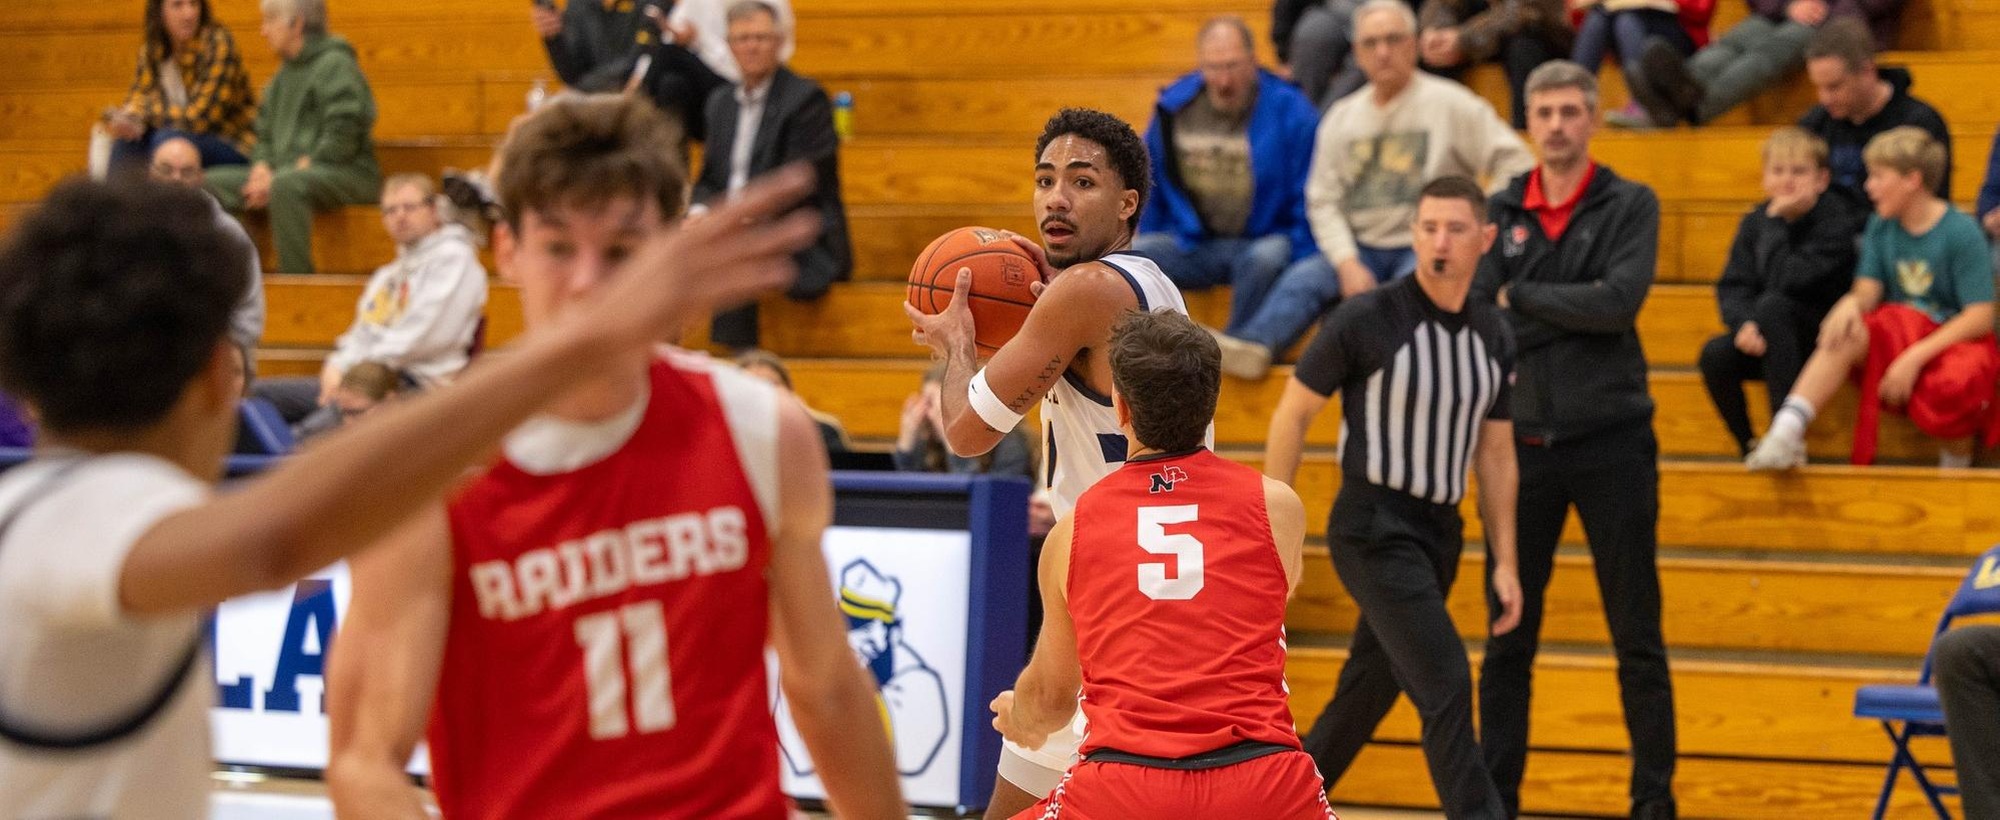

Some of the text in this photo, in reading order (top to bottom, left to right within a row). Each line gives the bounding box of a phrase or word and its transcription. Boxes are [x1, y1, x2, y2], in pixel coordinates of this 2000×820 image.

[469, 505, 749, 622] RAIDERS
[1136, 503, 1205, 601] 5
[573, 598, 677, 740] 11
